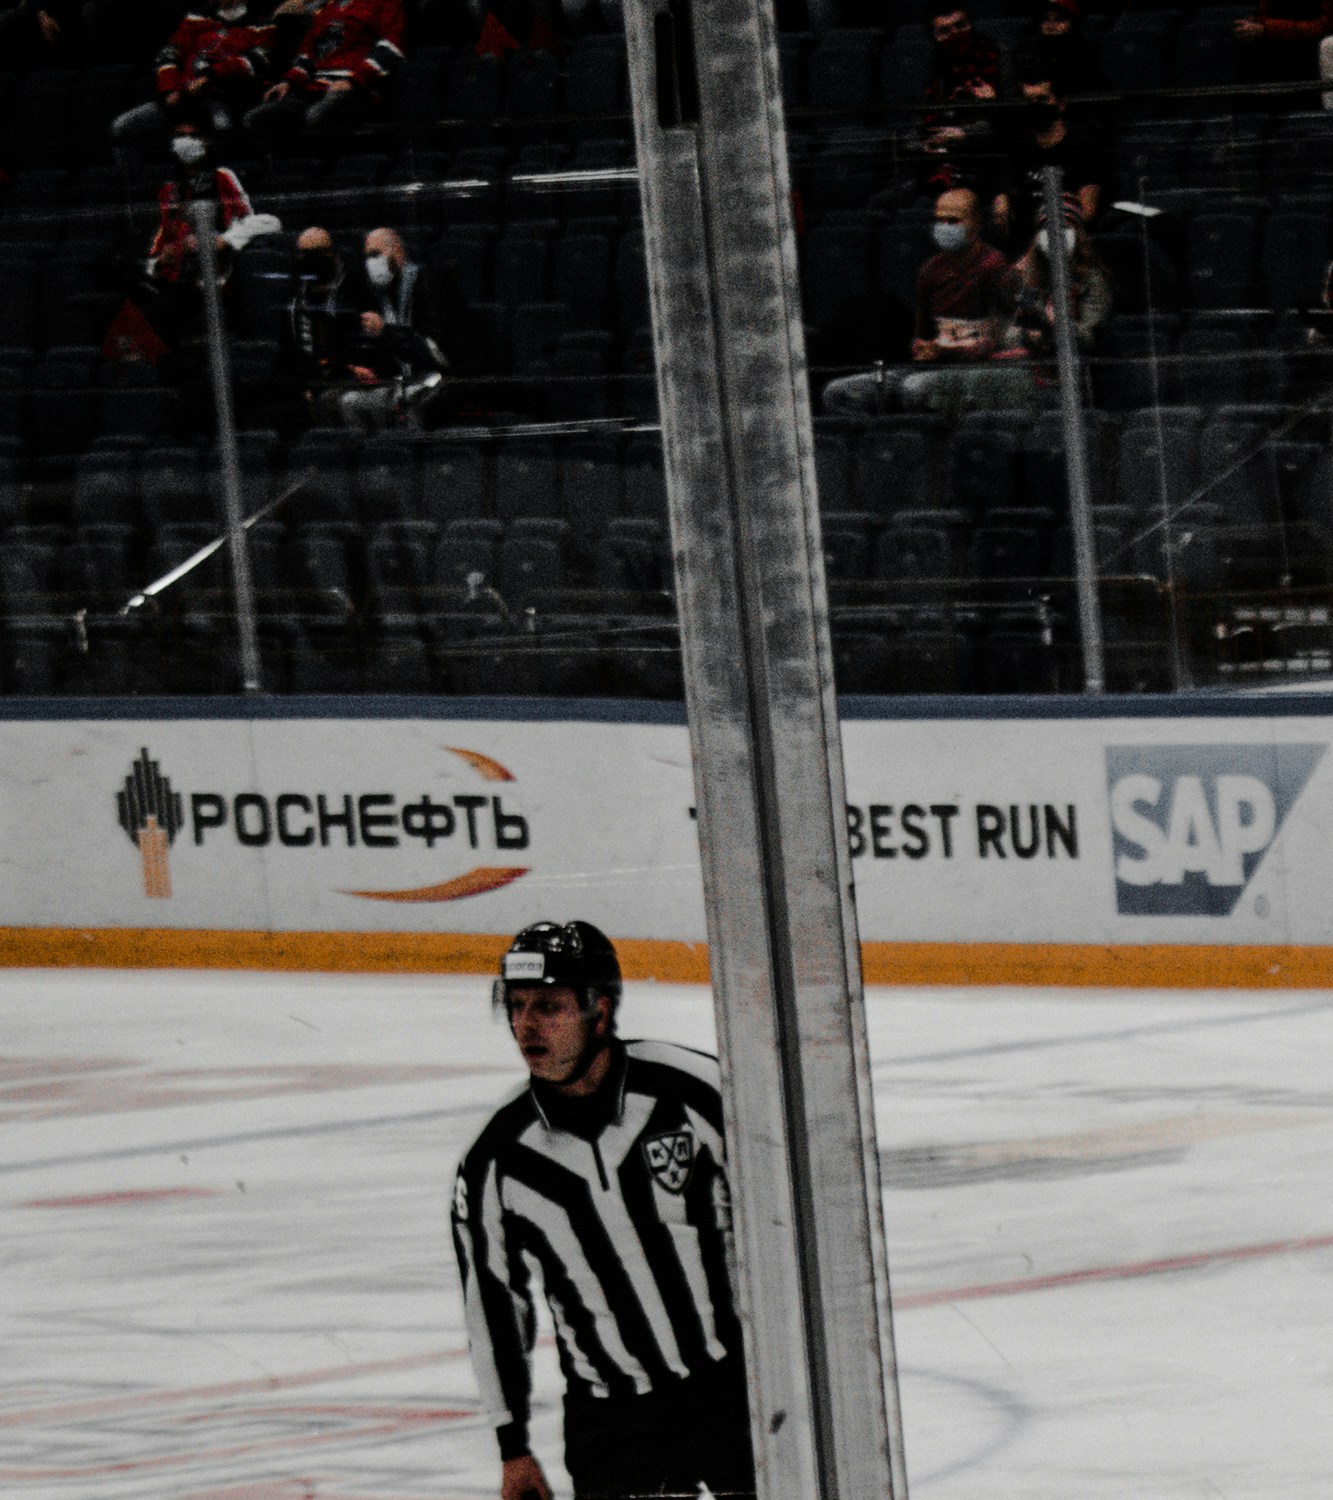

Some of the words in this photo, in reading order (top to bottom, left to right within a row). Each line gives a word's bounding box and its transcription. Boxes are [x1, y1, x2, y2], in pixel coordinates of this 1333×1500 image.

[191, 793, 531, 850] РОСНЕФТЬ
[845, 803, 959, 860] BEST
[977, 803, 1080, 860] RUN
[1109, 774, 1275, 887] SAP
